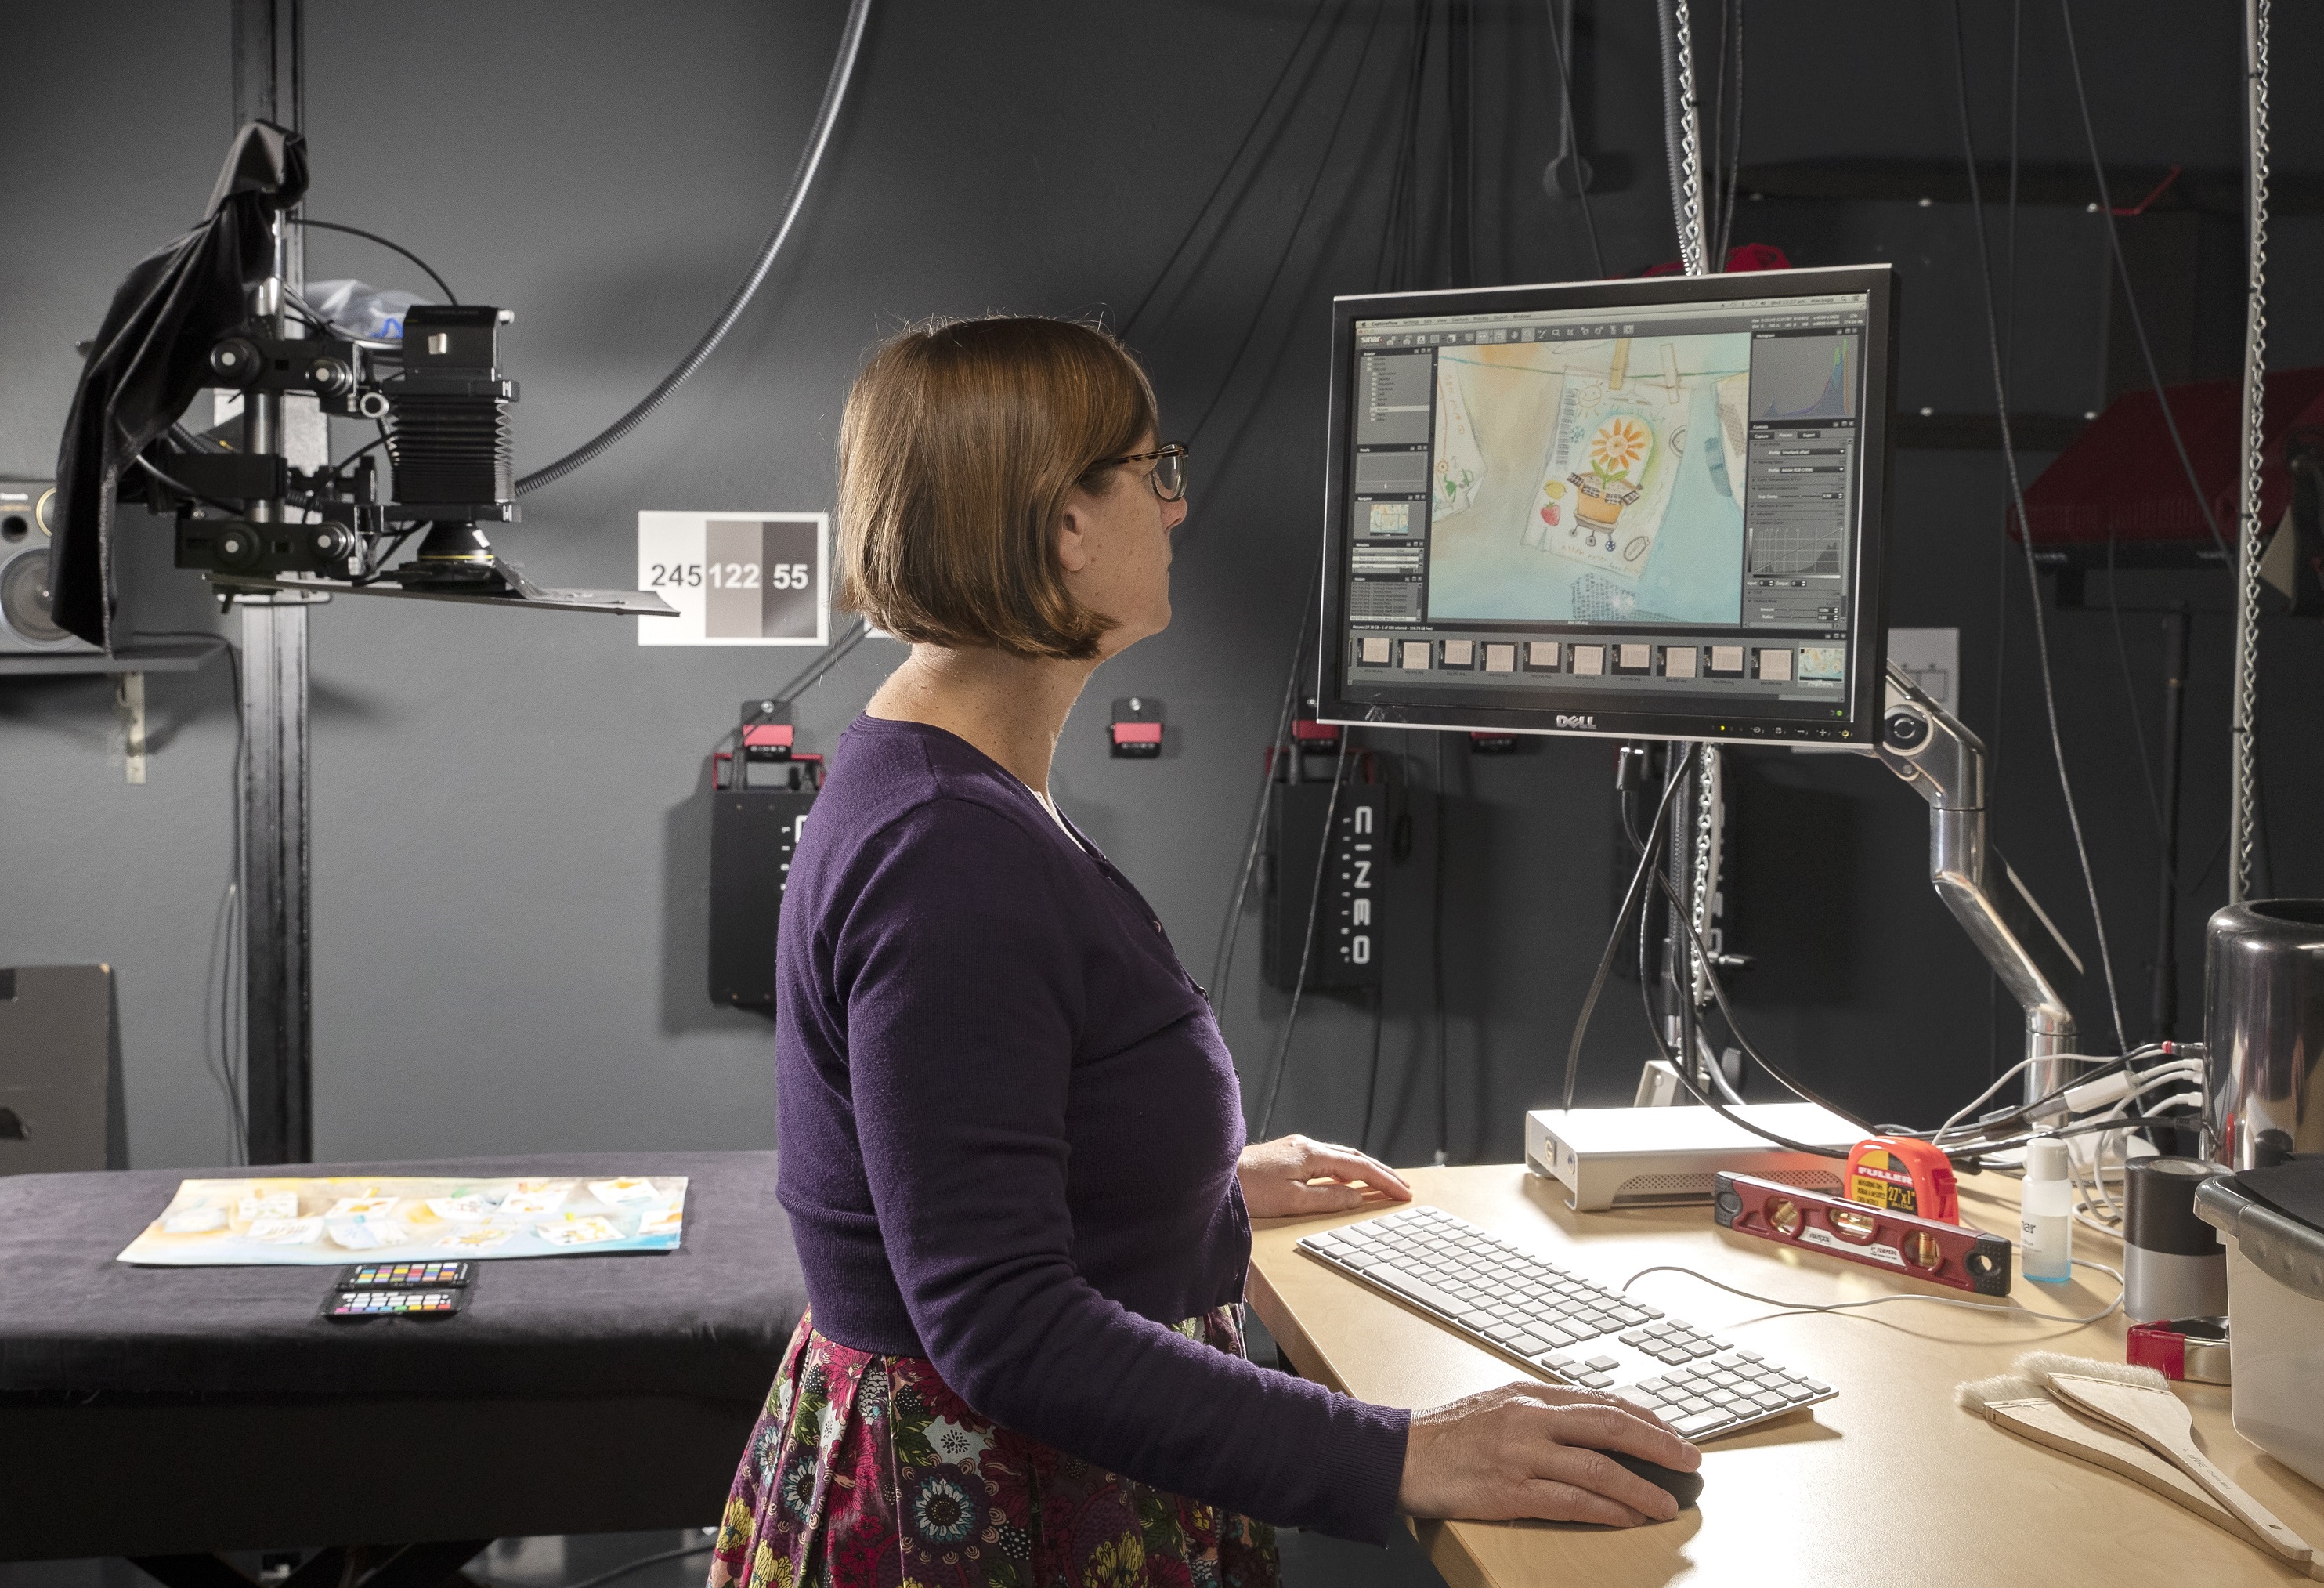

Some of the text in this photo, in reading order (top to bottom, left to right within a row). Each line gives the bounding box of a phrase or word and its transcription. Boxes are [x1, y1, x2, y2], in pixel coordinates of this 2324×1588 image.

[652, 562, 809, 590] 245 122 55
[1556, 714, 1597, 729] DELL
[1353, 805, 1372, 964] CINEO
[1858, 1167, 1913, 1185] FULLER
